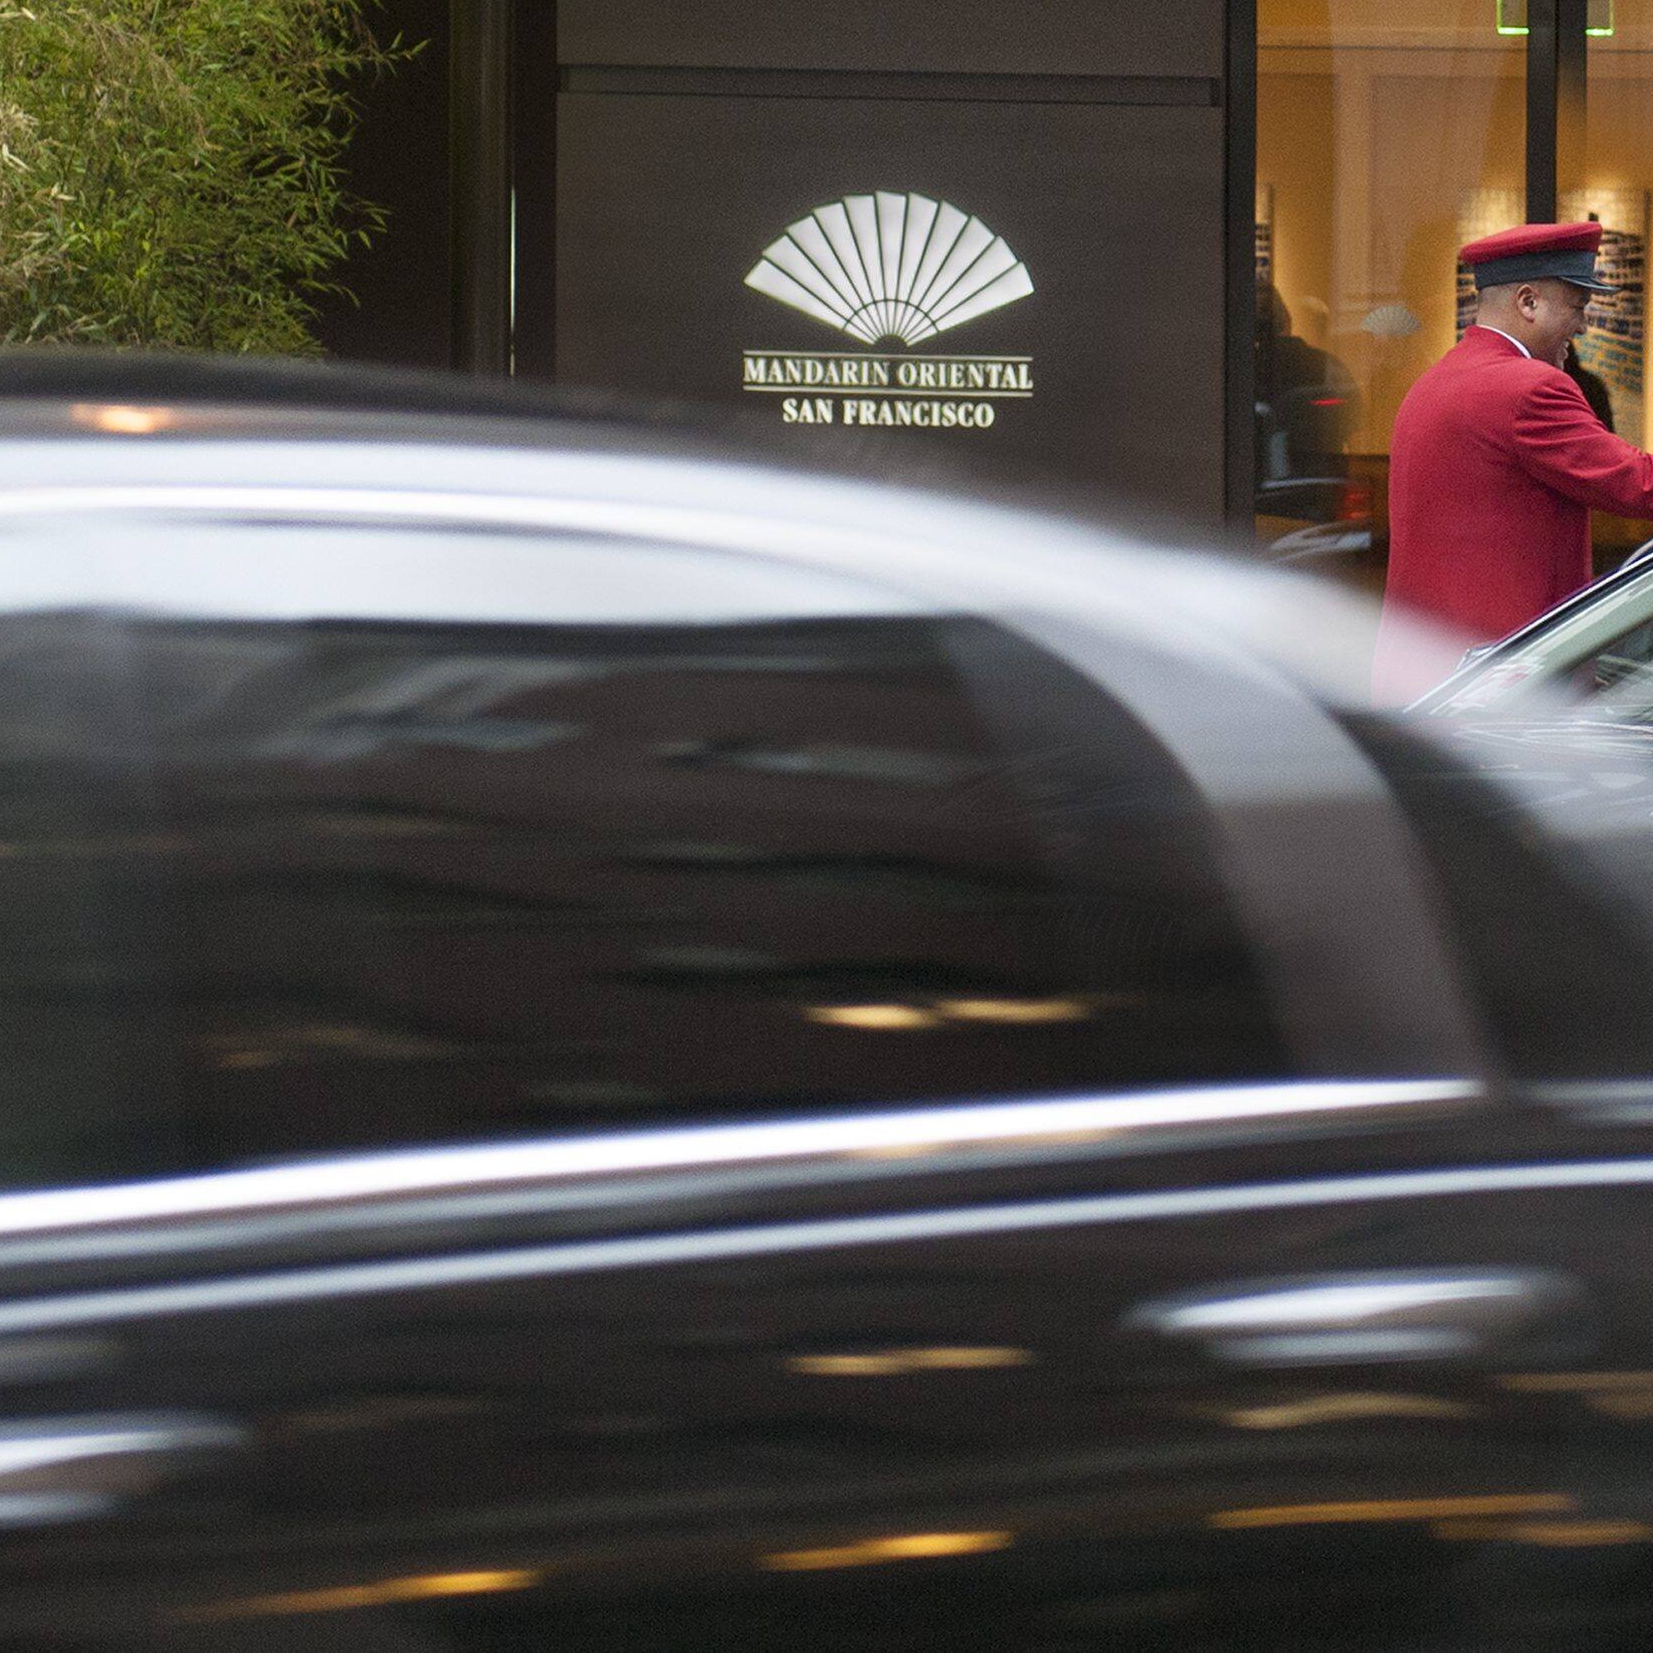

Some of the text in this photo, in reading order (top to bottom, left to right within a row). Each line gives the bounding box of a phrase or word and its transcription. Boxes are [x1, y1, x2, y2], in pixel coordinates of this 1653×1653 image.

[743, 357, 1034, 389] MANDARIN ORIENTAL
[782, 397, 995, 428] SAN FRANCISCO
